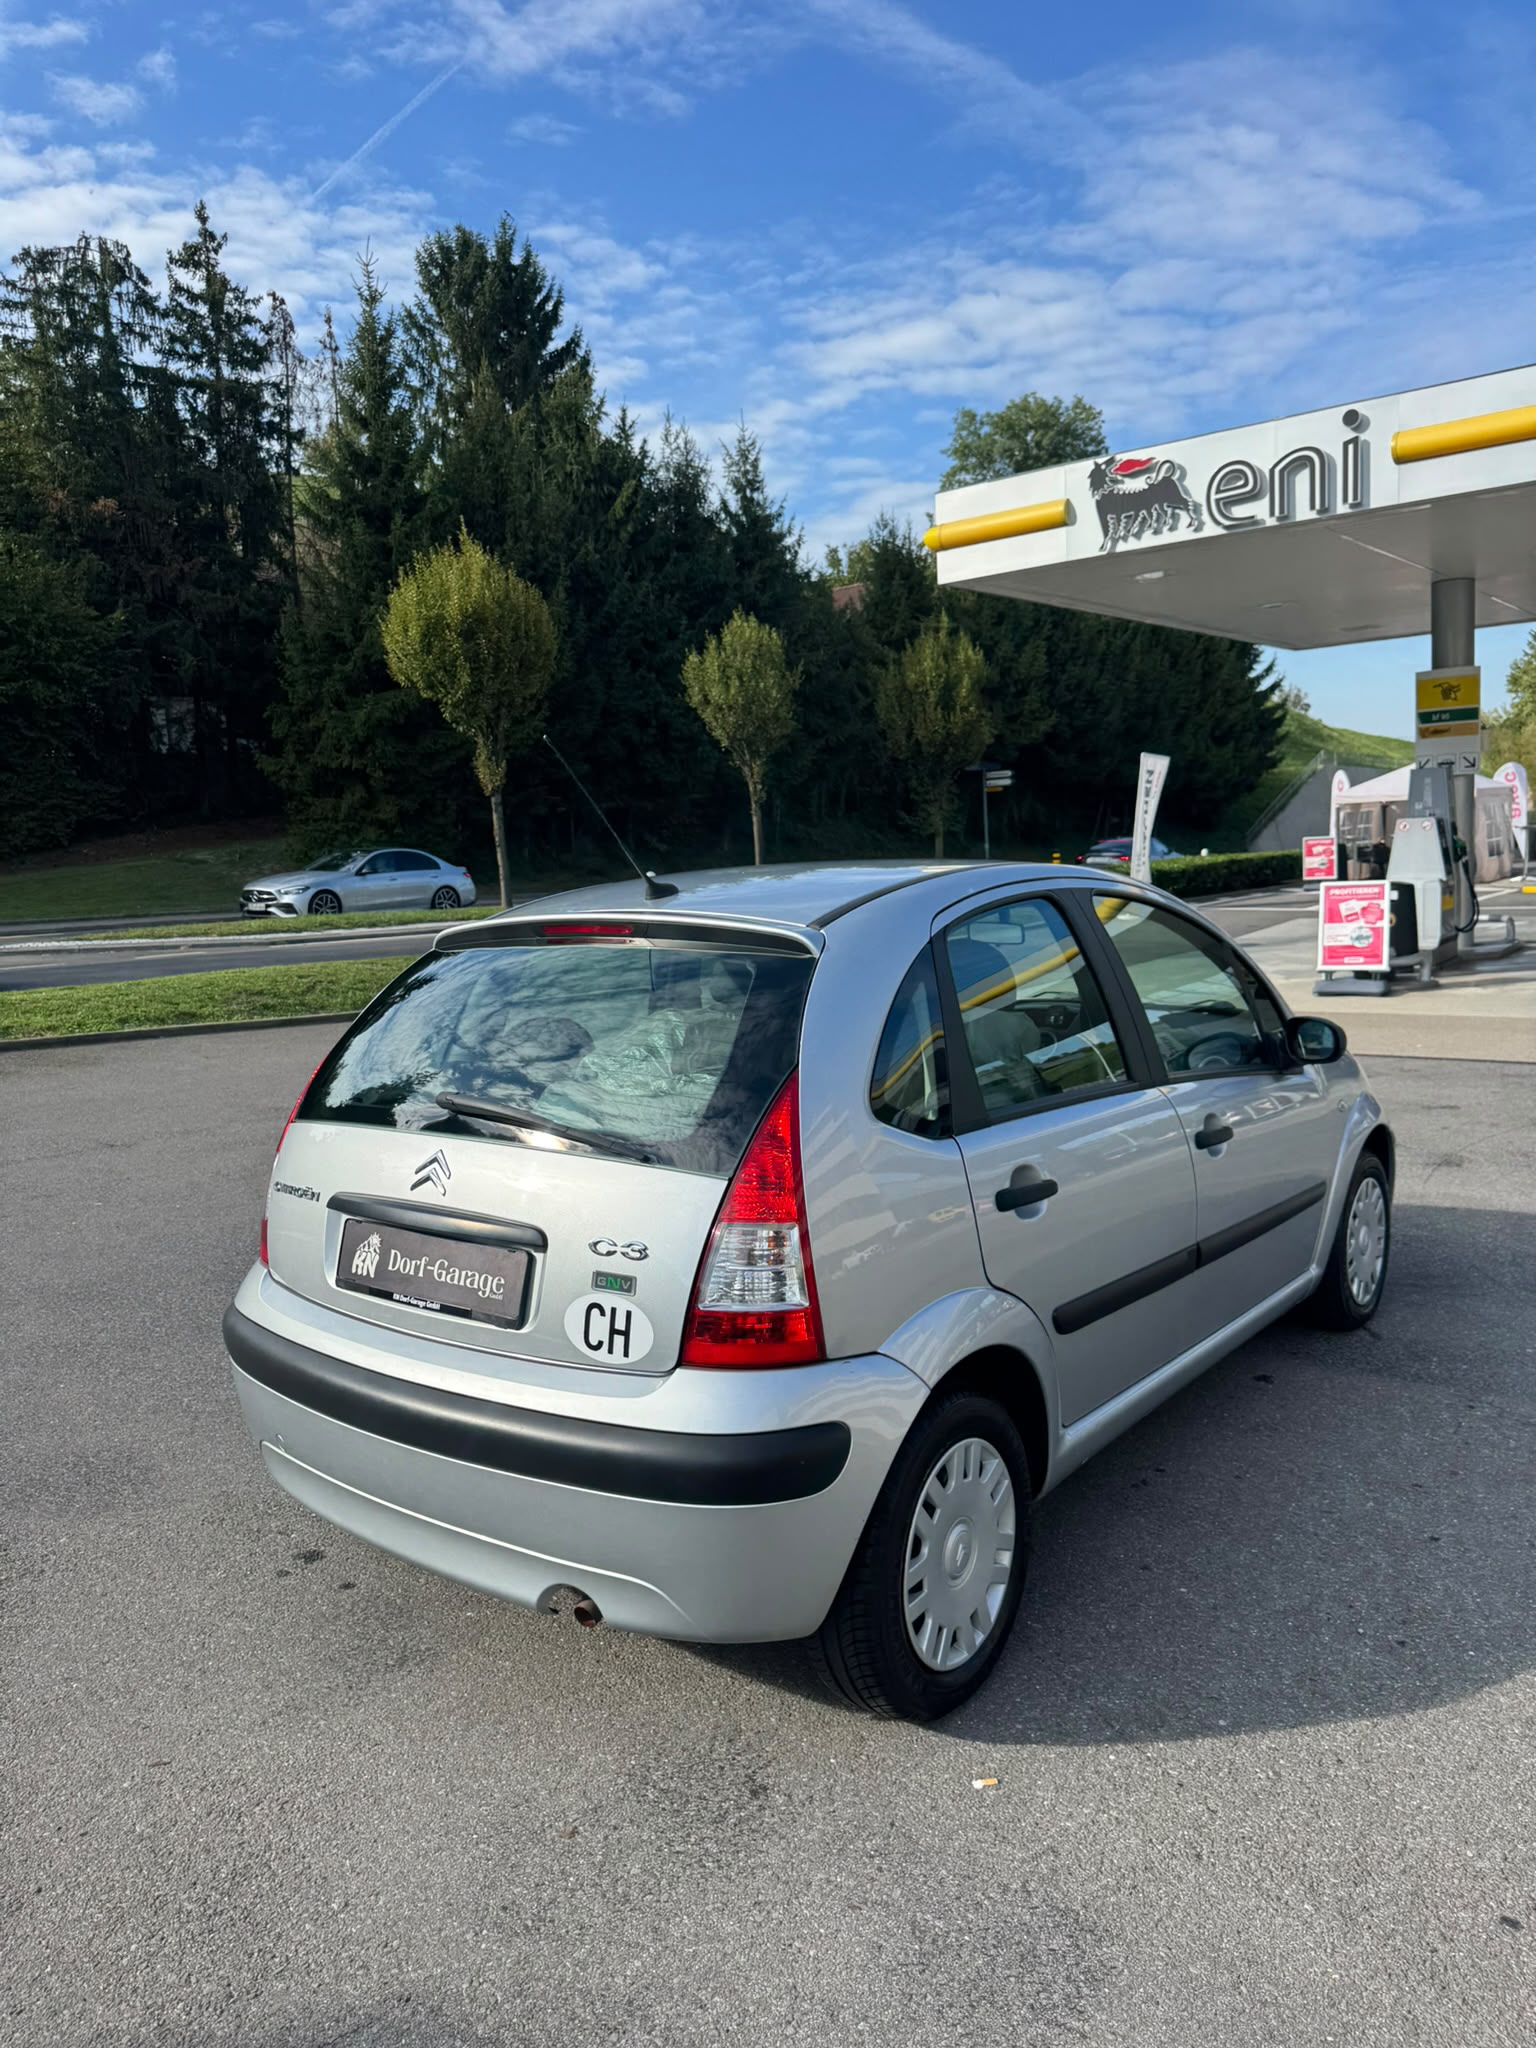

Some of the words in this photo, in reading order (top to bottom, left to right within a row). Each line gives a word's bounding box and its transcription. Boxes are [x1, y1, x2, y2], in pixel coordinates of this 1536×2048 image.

[1206, 408, 1362, 531] eni
[387, 1249, 505, 1297] Dorf-Garage
[597, 1276, 631, 1290] GNV
[400, 1294, 426, 1309] Dorf-Garage
[584, 1302, 632, 1358] CH
